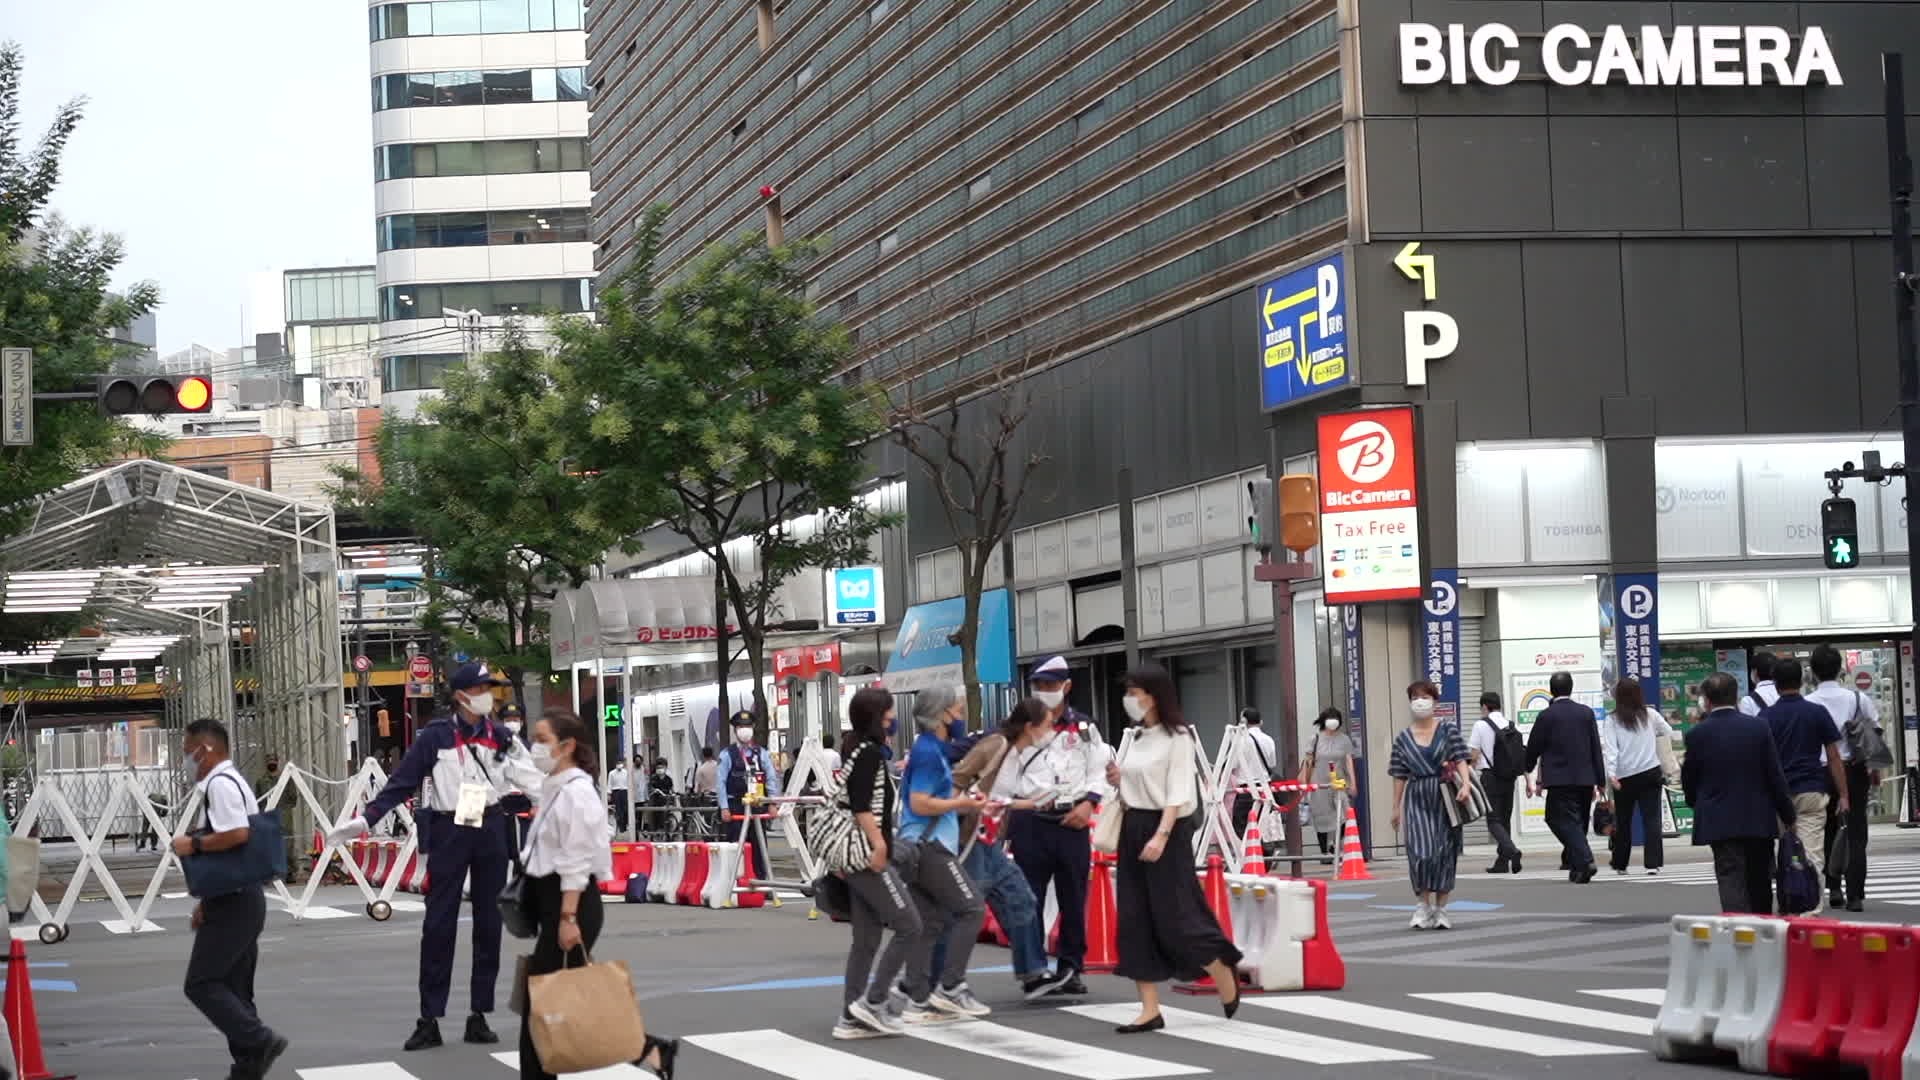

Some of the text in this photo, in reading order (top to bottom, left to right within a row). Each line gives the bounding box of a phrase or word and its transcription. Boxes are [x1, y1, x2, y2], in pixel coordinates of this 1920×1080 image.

[1399, 23, 1844, 86] BIC CAMERA
[1317, 264, 1339, 339] P
[1404, 311, 1459, 385] P
[1326, 489, 1411, 507] BicCamera
[1679, 487, 1726, 501] Norton
[1334, 521, 1406, 537] Tax Free
[1544, 525, 1603, 537] TOSHIBA
[1630, 591, 1646, 613] P
